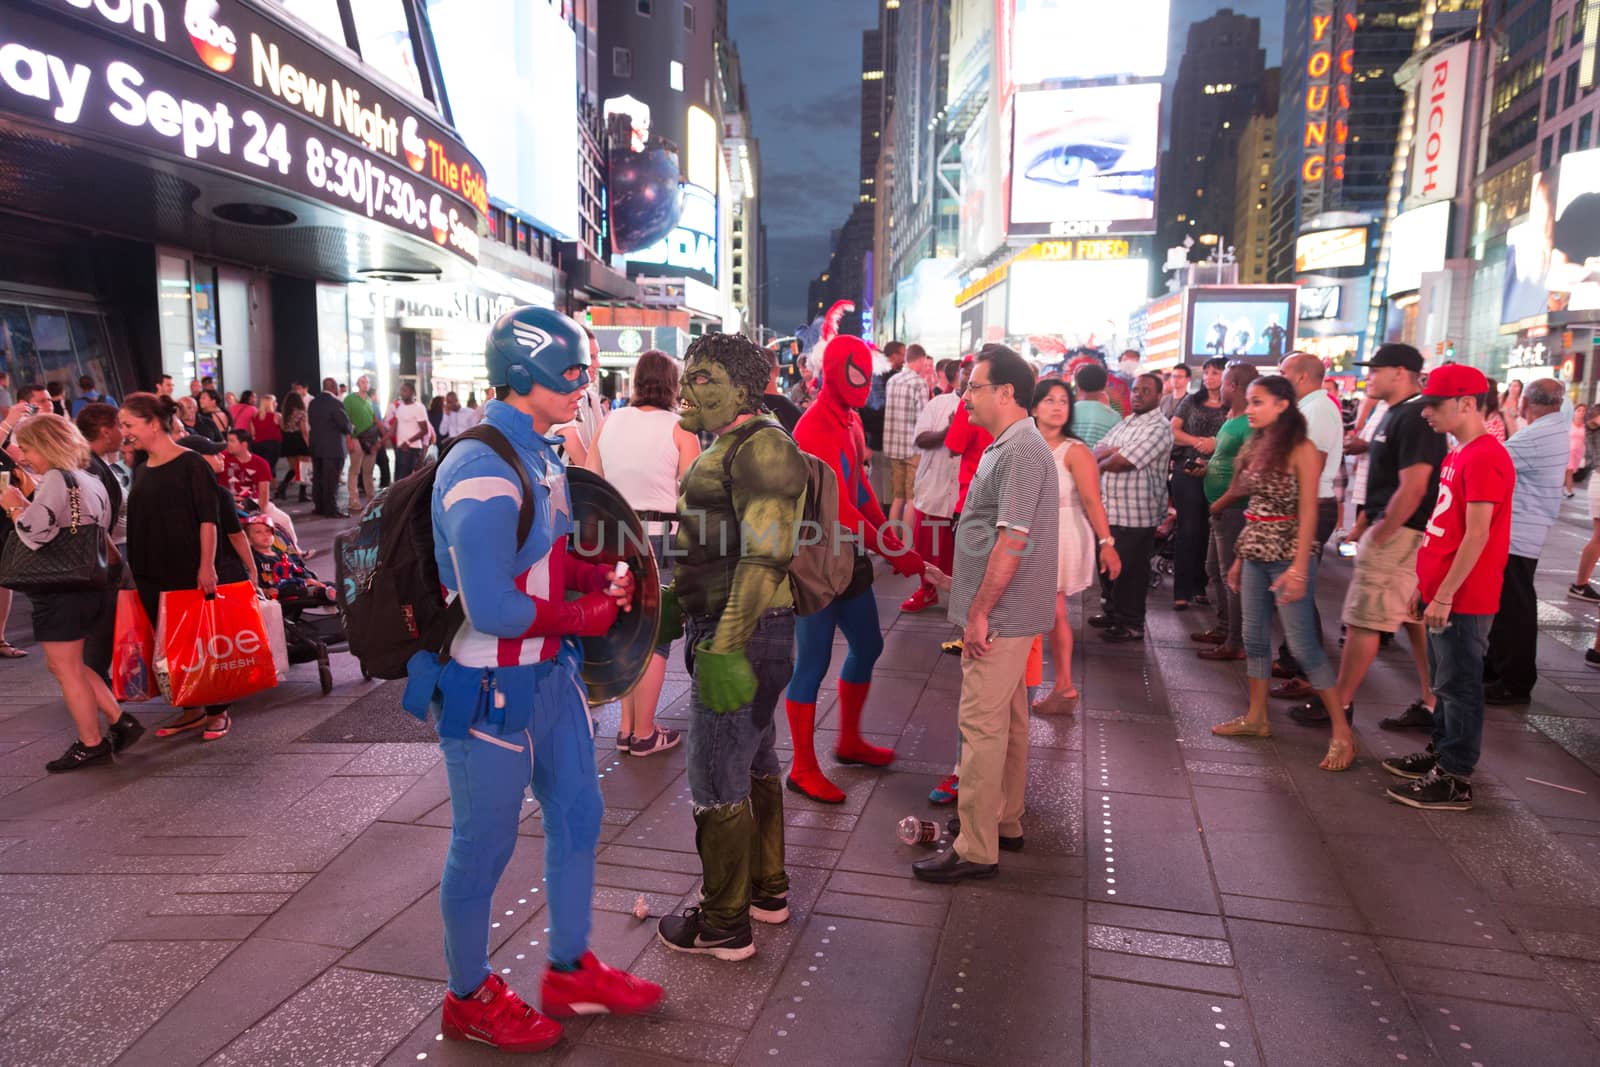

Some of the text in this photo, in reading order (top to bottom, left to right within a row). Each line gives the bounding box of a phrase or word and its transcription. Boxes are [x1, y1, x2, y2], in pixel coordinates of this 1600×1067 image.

[0, 43, 91, 123] ay
[106, 61, 234, 159] Sept
[241, 110, 291, 174] 24
[250, 33, 326, 118] New
[331, 77, 398, 157] Night
[427, 138, 459, 191] The
[1302, 15, 1331, 181] YOUNG
[1423, 60, 1449, 192] RICOH
[1050, 220, 1112, 235] SONY
[212, 656, 256, 673] FRESH
